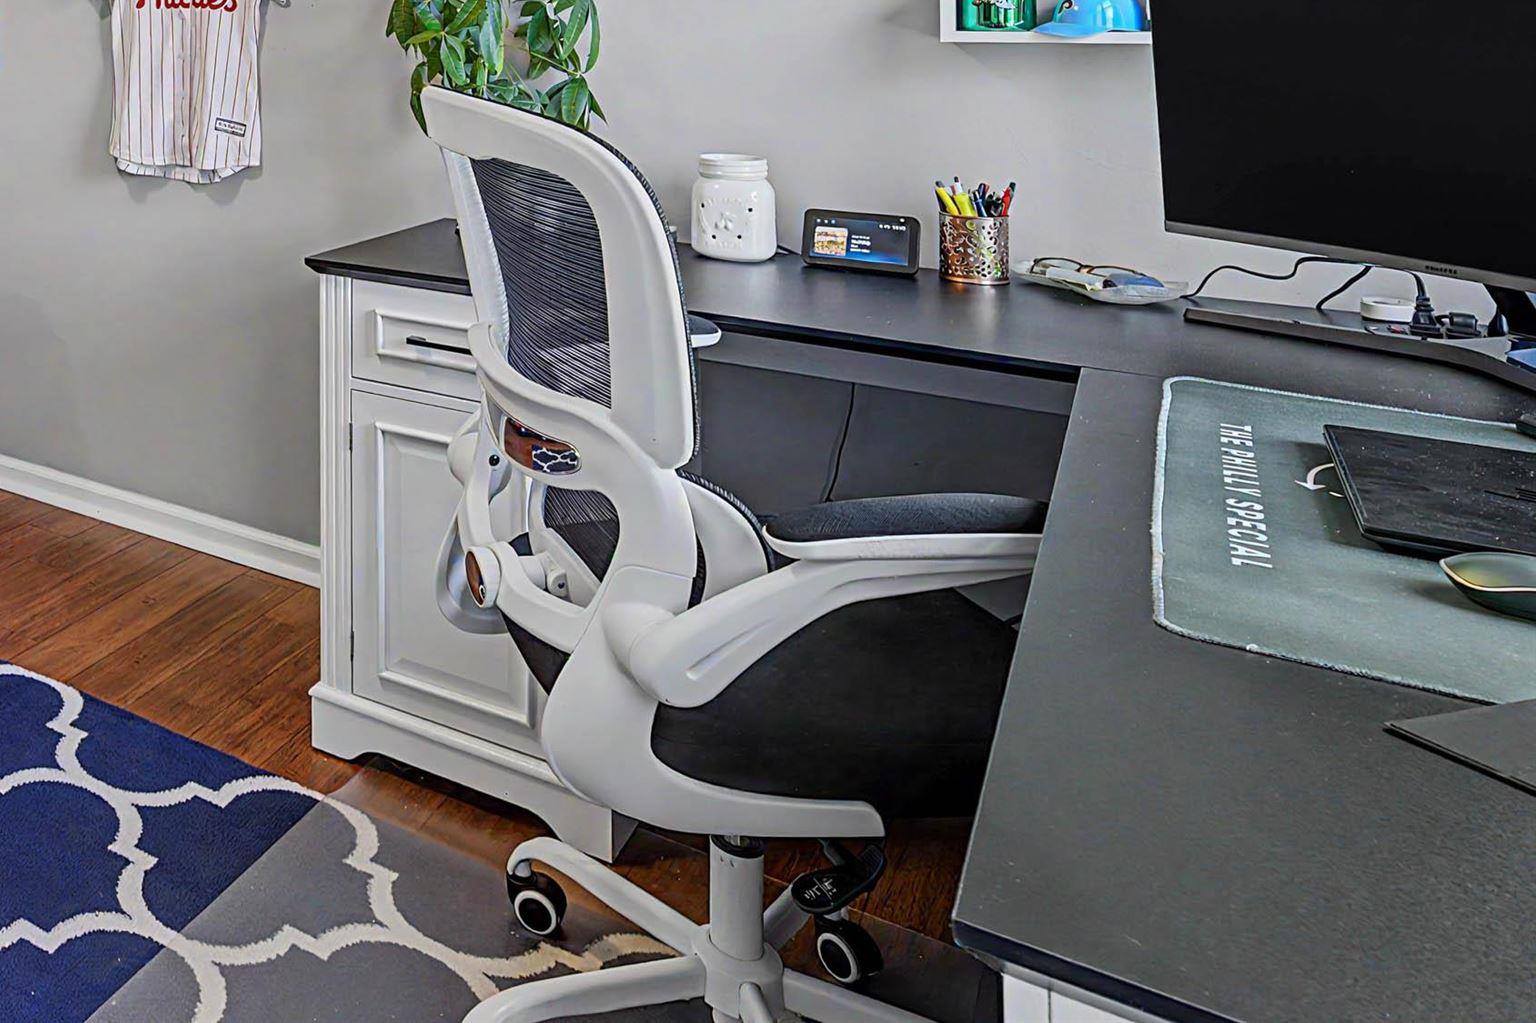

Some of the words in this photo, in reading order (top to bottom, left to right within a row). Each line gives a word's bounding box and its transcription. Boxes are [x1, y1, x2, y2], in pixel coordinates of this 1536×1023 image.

[1220, 423, 1253, 446] THE
[1221, 447, 1262, 497] PHILLY
[1225, 498, 1272, 568] SPECIAL
